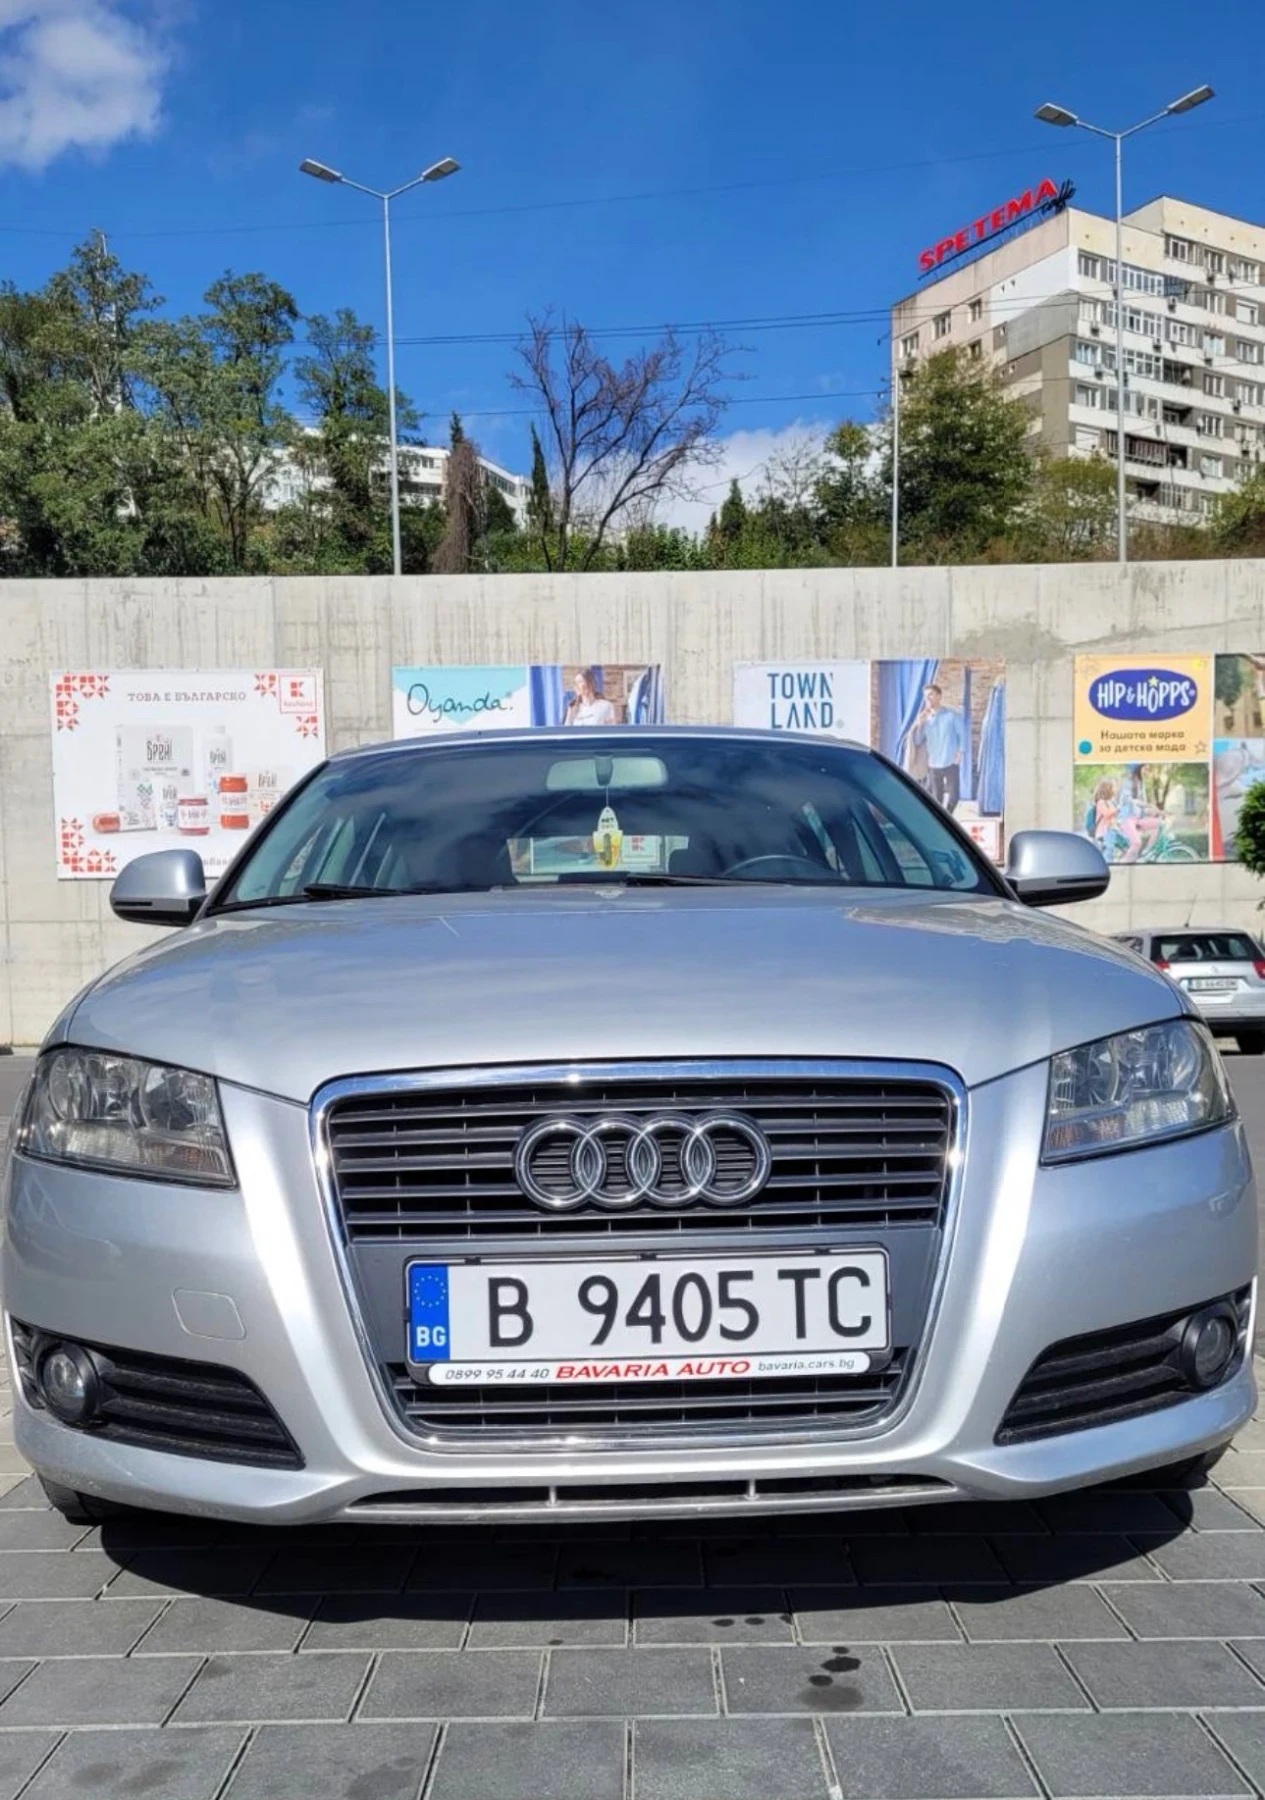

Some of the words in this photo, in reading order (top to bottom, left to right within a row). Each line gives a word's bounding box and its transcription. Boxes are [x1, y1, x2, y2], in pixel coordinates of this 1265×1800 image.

[918, 178, 1058, 271] SPETEMA
[767, 672, 833, 699] TOWN
[128, 692, 160, 702] ТОВА
[164, 692, 171, 701] Е
[175, 691, 247, 702] БЪЛГАРСКО
[771, 702, 833, 729] LAND
[1100, 730, 1146, 740] Нашата
[1149, 730, 1185, 741] марка
[1099, 744, 1111, 752] за
[1114, 743, 1153, 753] детска
[488, 1277, 533, 1347] B
[578, 1270, 759, 1345] 9405
[778, 1266, 871, 1339] TC
[416, 1326, 447, 1347] BG
[445, 1368, 482, 1380] 0899
[486, 1368, 504, 1380] 95
[507, 1368, 526, 1380] 44
[529, 1367, 550, 1379] 40
[556, 1363, 669, 1379] BAVARIA
[676, 1361, 750, 1376] AUTO
[758, 1359, 855, 1372] bavaria.cars.bg
